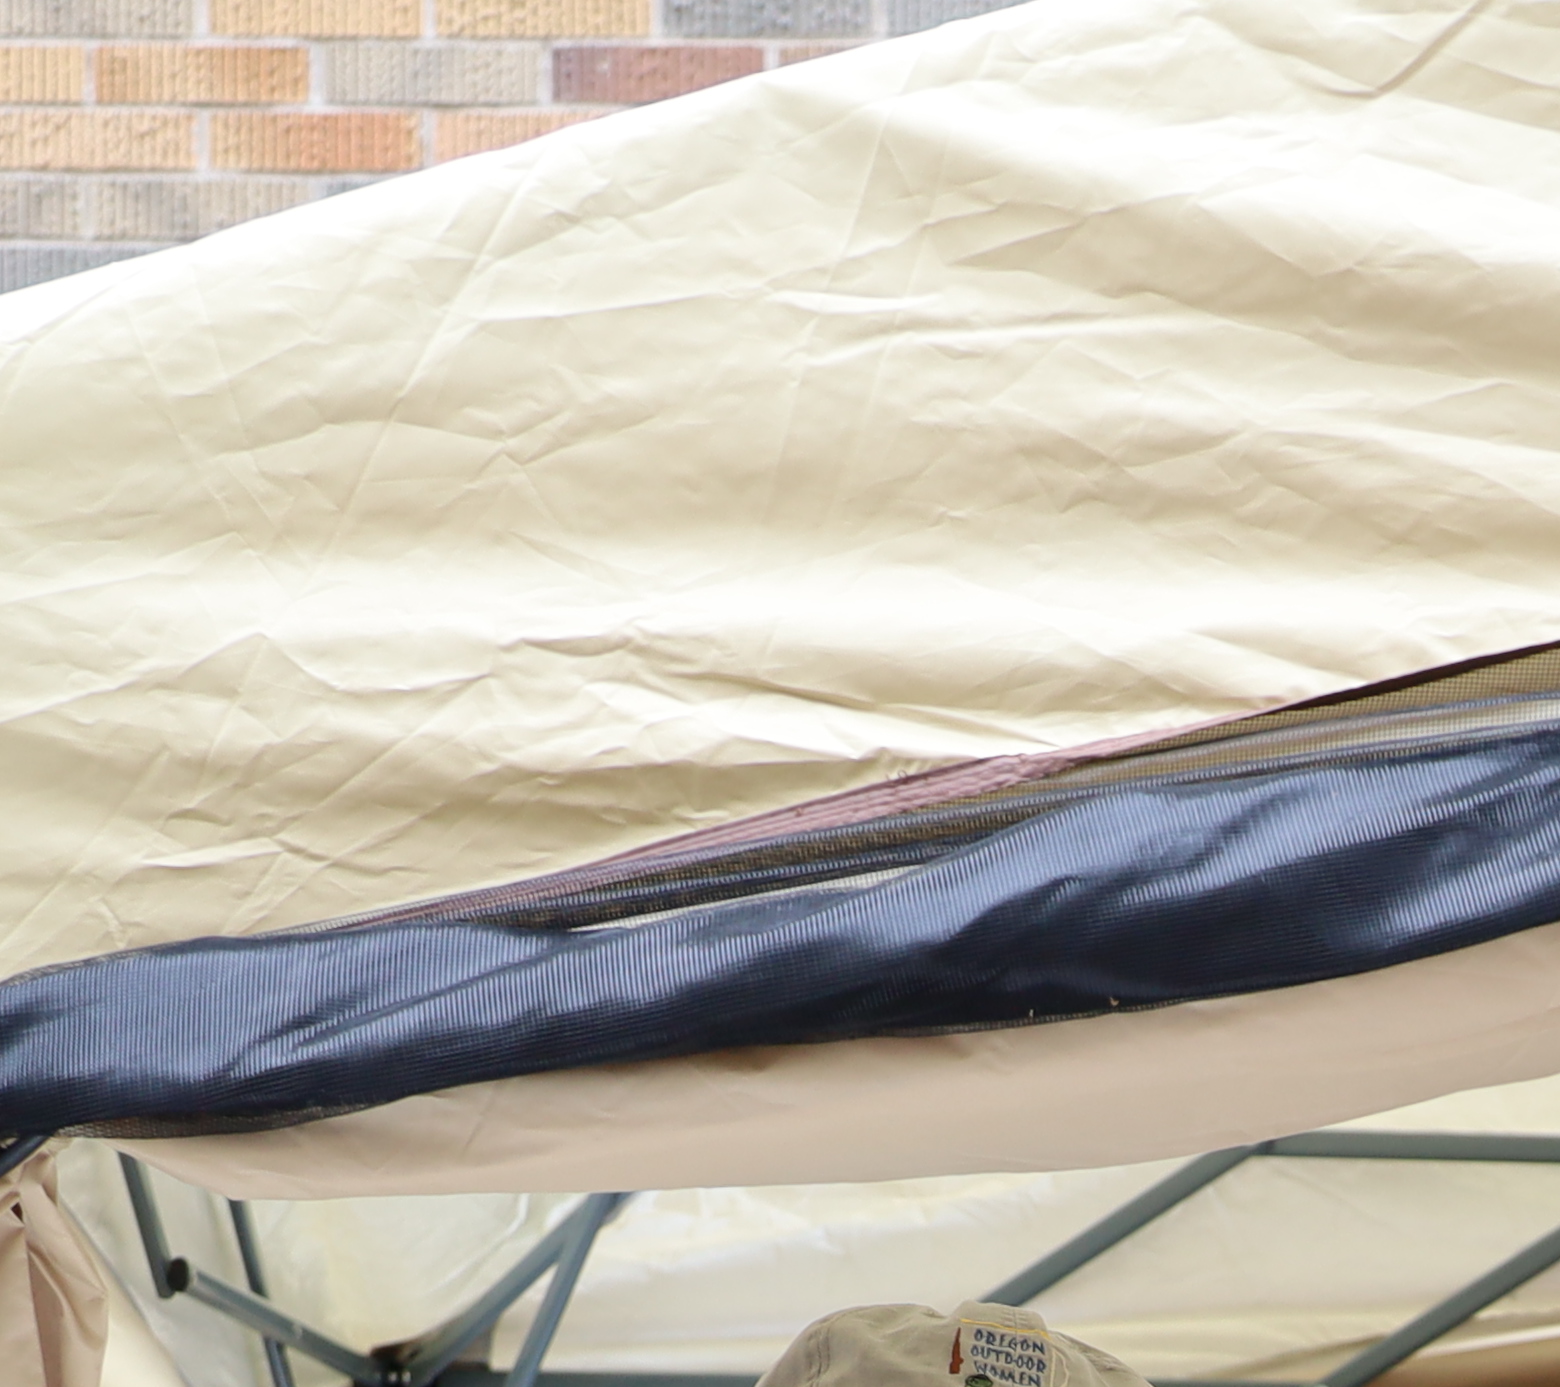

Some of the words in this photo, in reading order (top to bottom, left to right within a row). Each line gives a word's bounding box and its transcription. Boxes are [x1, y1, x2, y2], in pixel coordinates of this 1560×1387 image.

[973, 1328, 1046, 1356] OREGON
[970, 1344, 1047, 1374] OUTDOOR
[973, 1360, 1042, 1387] WOMEN
